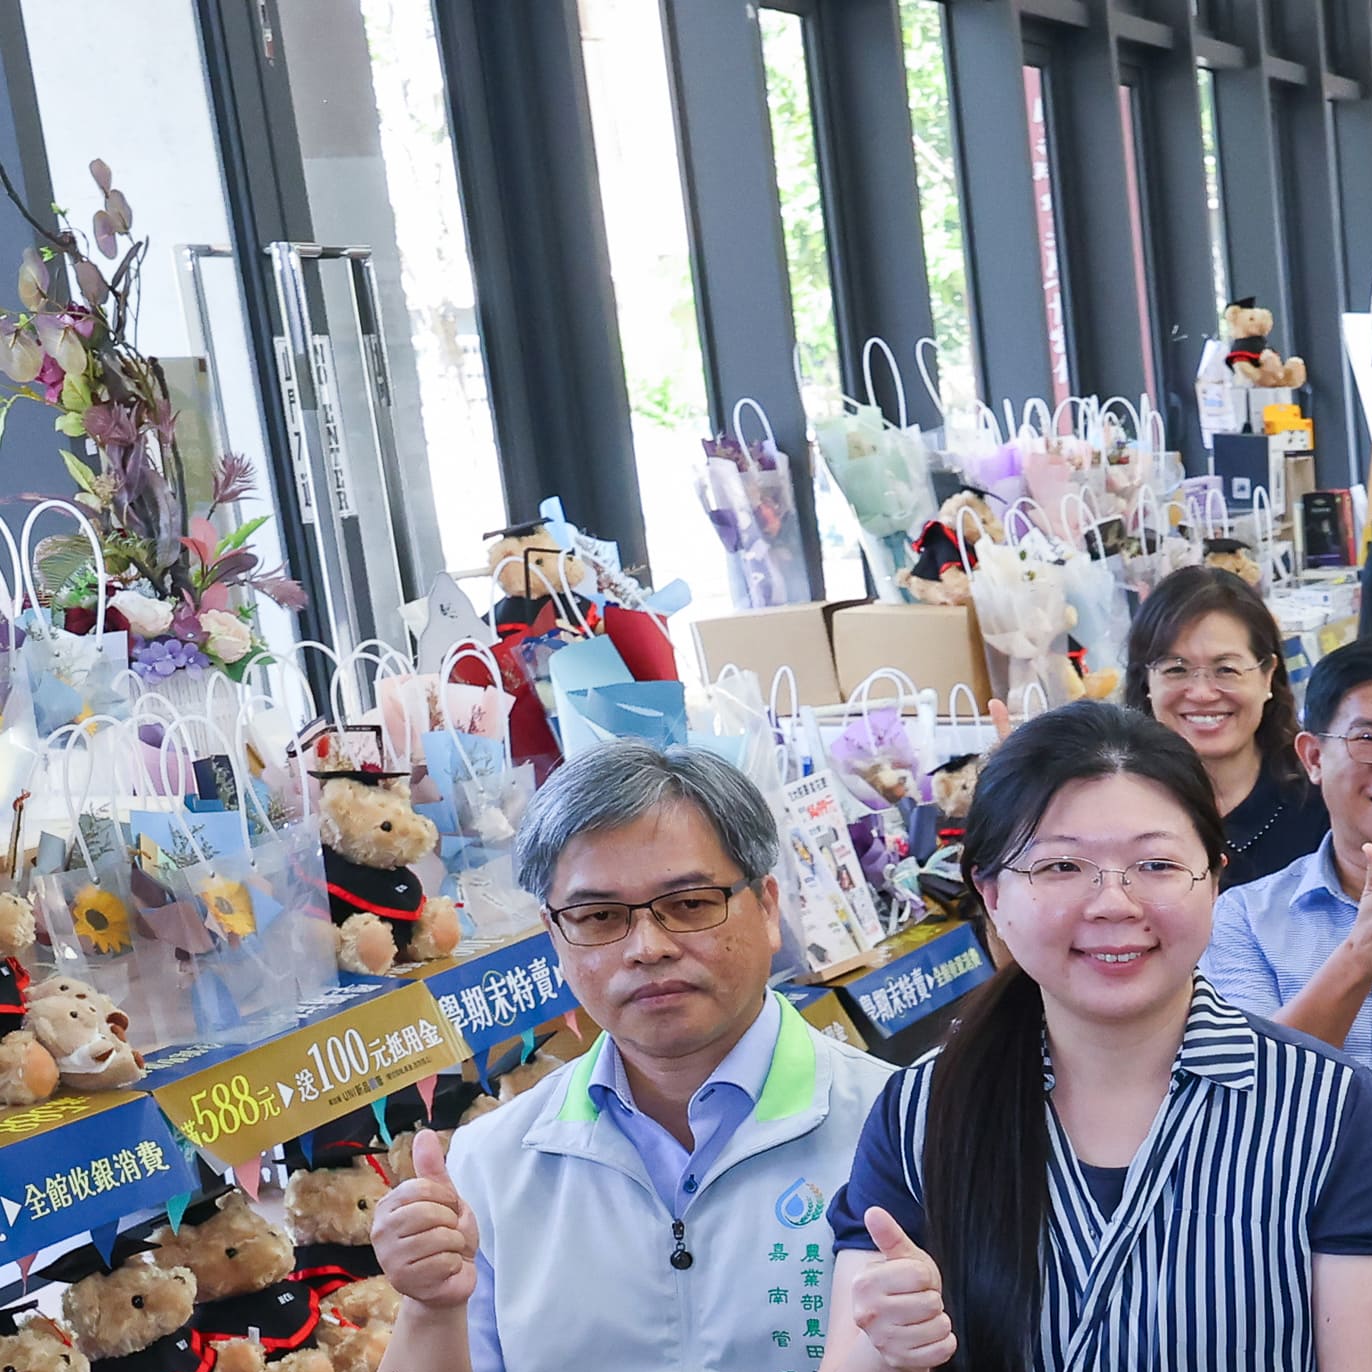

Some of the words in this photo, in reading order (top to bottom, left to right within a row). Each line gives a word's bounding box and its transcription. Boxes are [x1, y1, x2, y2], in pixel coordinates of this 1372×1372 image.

[439, 956, 558, 1036] 學期末特賣
[295, 1017, 445, 1103] 送100元抵用金
[24, 1140, 171, 1221] 全館收銀消費
